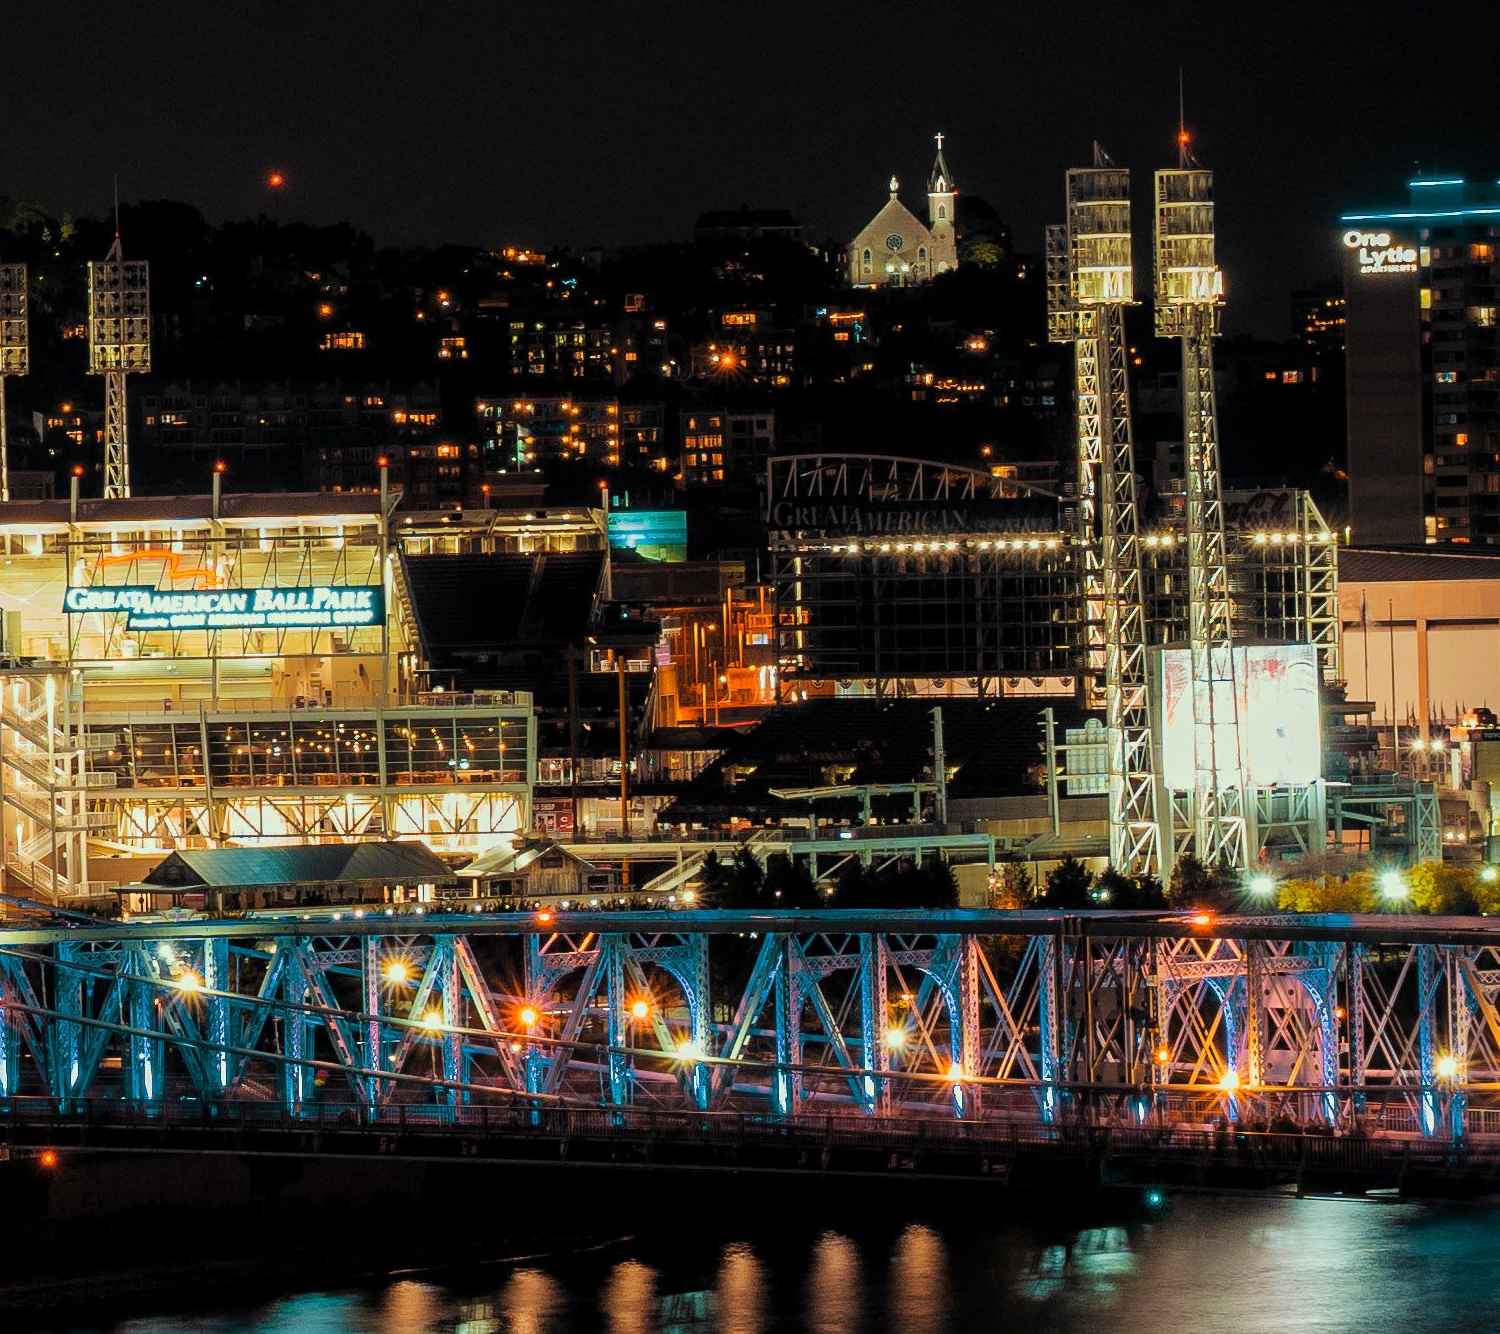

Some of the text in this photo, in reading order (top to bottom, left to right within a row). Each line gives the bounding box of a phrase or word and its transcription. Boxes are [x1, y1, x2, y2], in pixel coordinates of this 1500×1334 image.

[1343, 231, 1391, 247] One
[773, 501, 850, 527] GREAT
[845, 506, 971, 531] AMERICAN
[66, 587, 373, 614] GREAT AMERICAN BALL PARK
